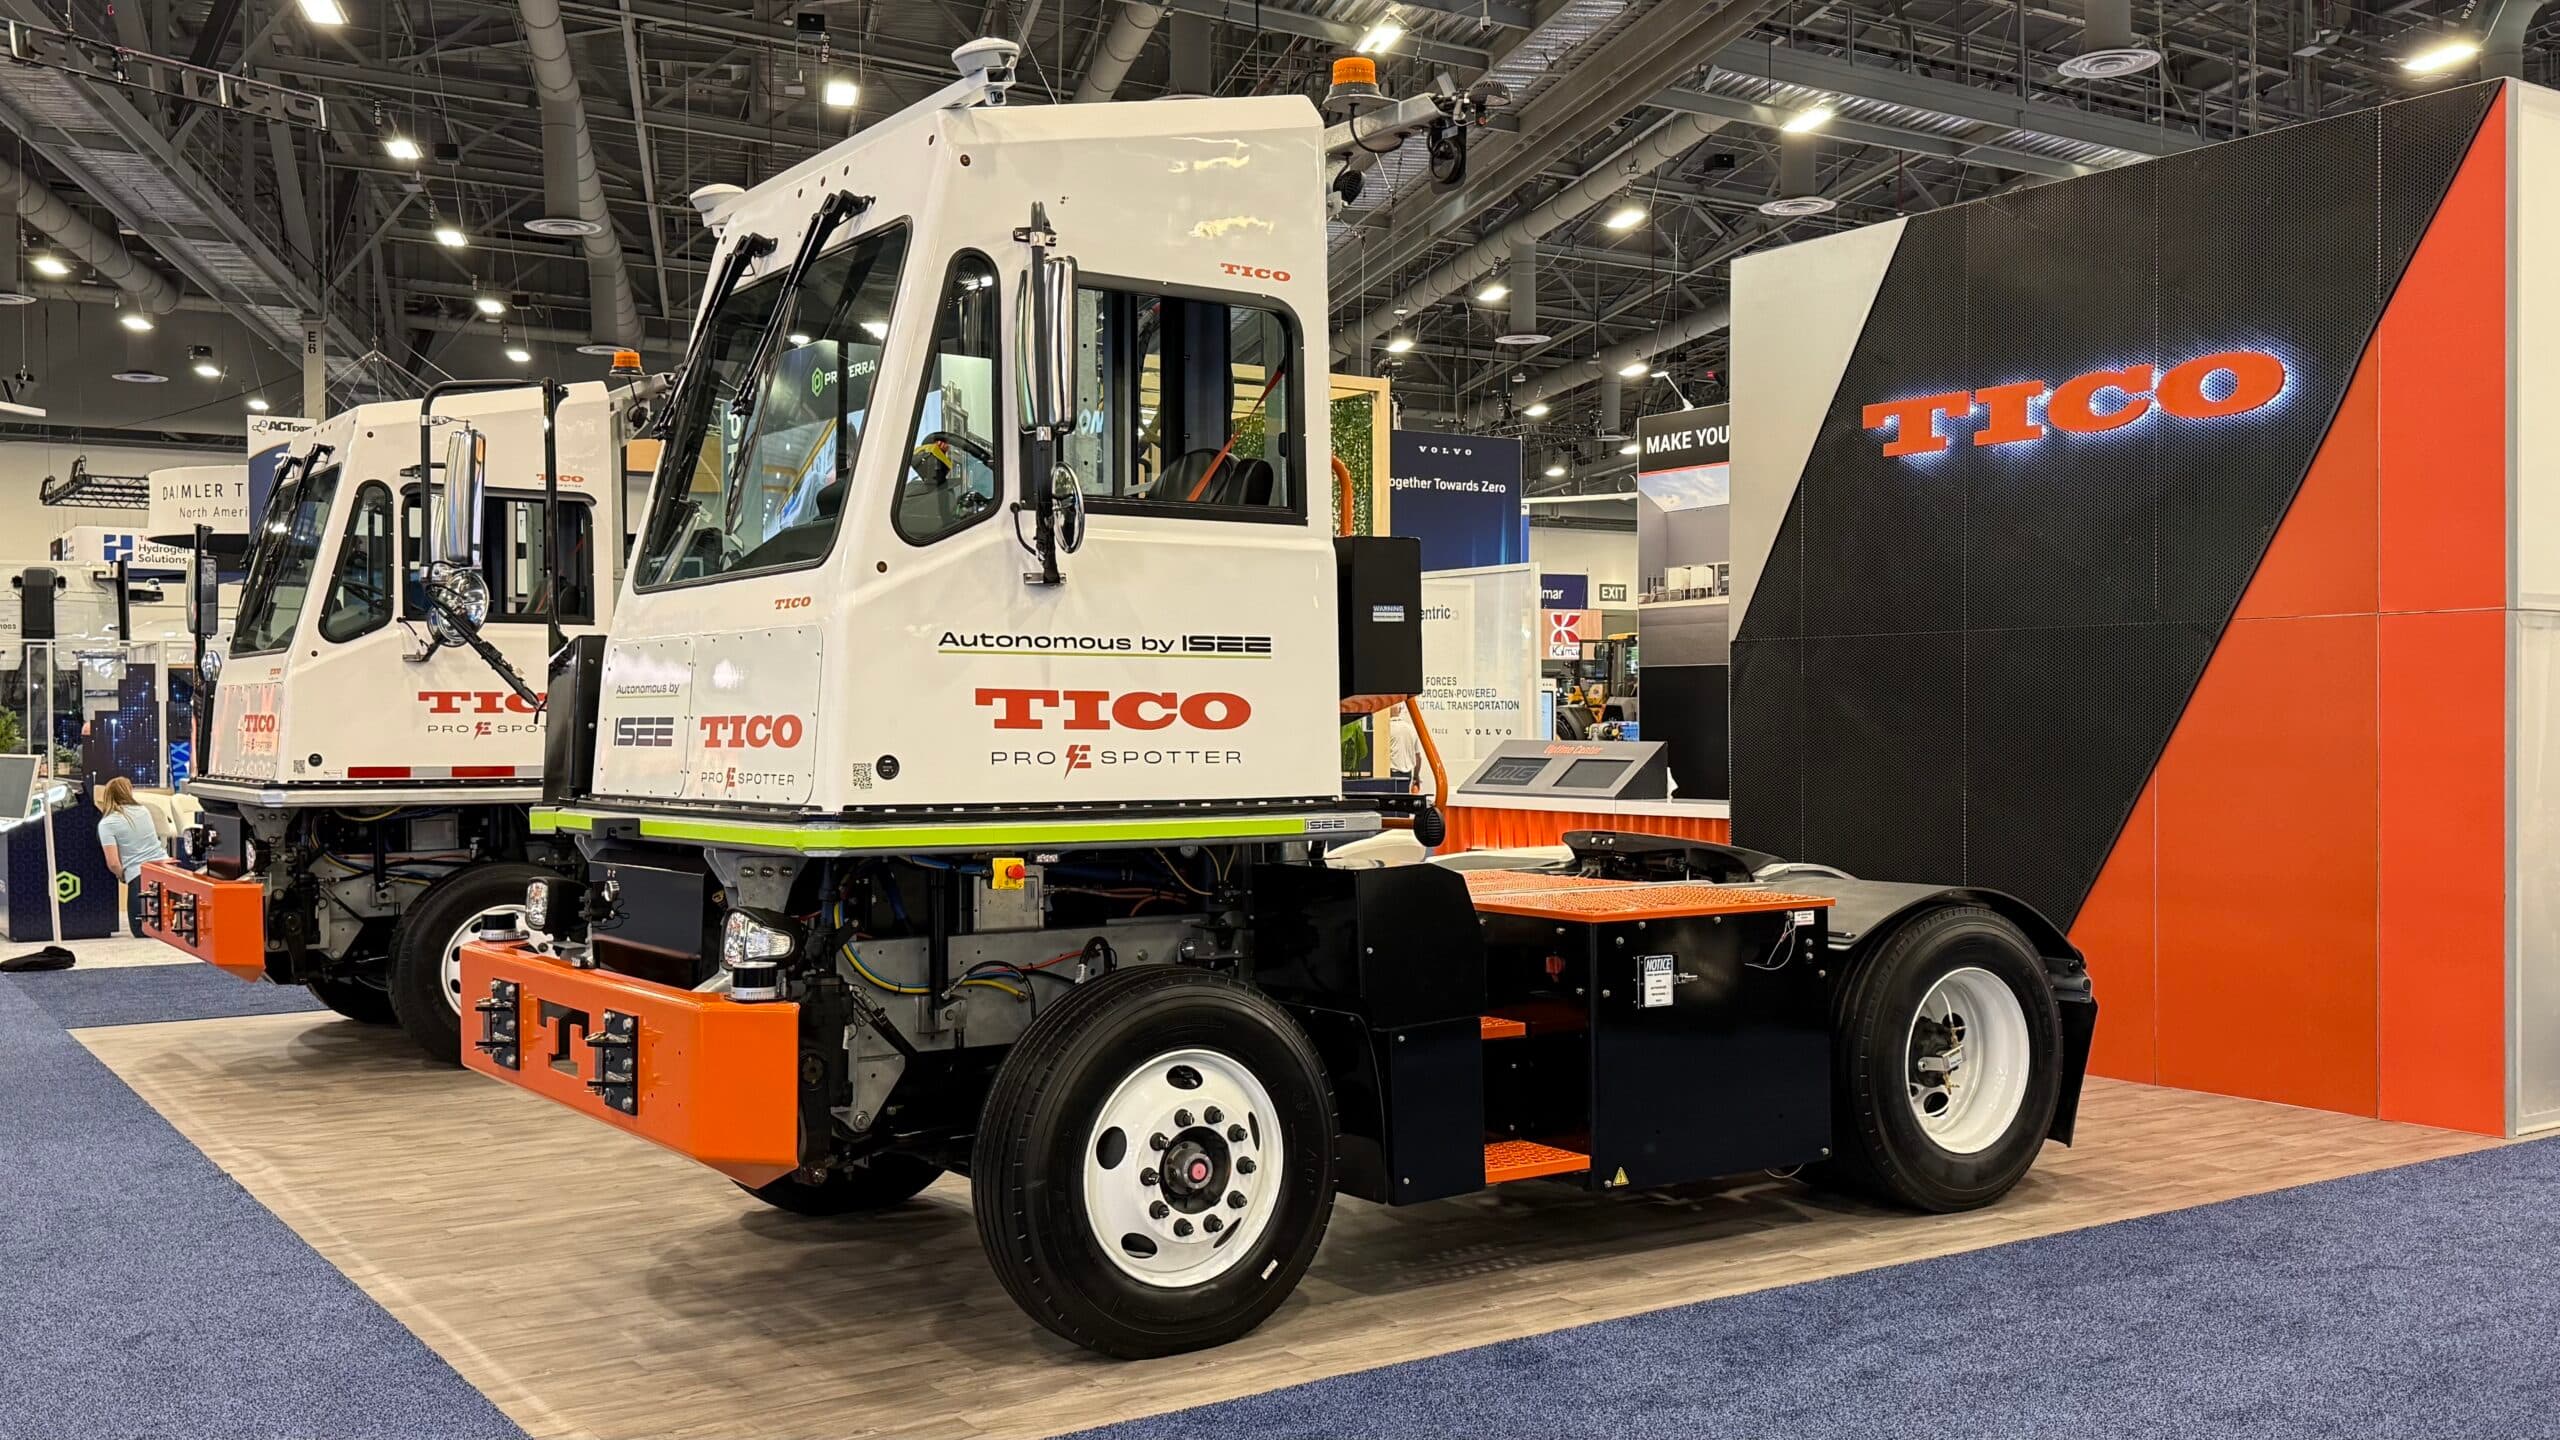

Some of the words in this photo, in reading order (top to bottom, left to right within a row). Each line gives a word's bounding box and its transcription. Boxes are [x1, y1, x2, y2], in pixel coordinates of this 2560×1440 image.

[1221, 263, 1291, 282] TICO
[824, 359, 876, 386] PRERRA
[1862, 350, 2285, 458] TICO
[1646, 430, 1692, 454] MAKE
[1695, 425, 1730, 447] YOU
[1419, 446, 1472, 456] VOLVO
[536, 473, 585, 483] TCO
[162, 483, 223, 500] DAIMLER
[1434, 478, 1479, 492] Towards
[1481, 480, 1506, 493] Zero
[179, 506, 208, 518] North
[213, 505, 248, 518] Ameri
[138, 543, 190, 555] Hydrogen
[138, 553, 188, 564] Solutions
[1602, 586, 1625, 600] EXIT
[774, 596, 812, 609] TICO
[938, 631, 1132, 650] Autonomous
[1141, 636, 1175, 653] by
[1182, 635, 1272, 653] ISEE
[1425, 676, 1457, 686] FORCES
[616, 683, 667, 695] Autonomous
[669, 683, 680, 694] by
[974, 688, 1251, 730] TICO
[1447, 701, 1519, 711] TRANSPORTATION
[244, 714, 275, 732] TICO
[428, 725, 469, 733] PRO
[614, 717, 674, 747] ISEE
[700, 714, 803, 749] TICO
[1465, 728, 1512, 736] VOLVO
[991, 751, 1056, 766] PRO
[1100, 750, 1242, 765] SPOTTER
[701, 771, 723, 783] PRO
[738, 773, 795, 786] SPOTTER
[1306, 820, 1345, 830] ISEE
[1646, 958, 1672, 971] NOTICE
